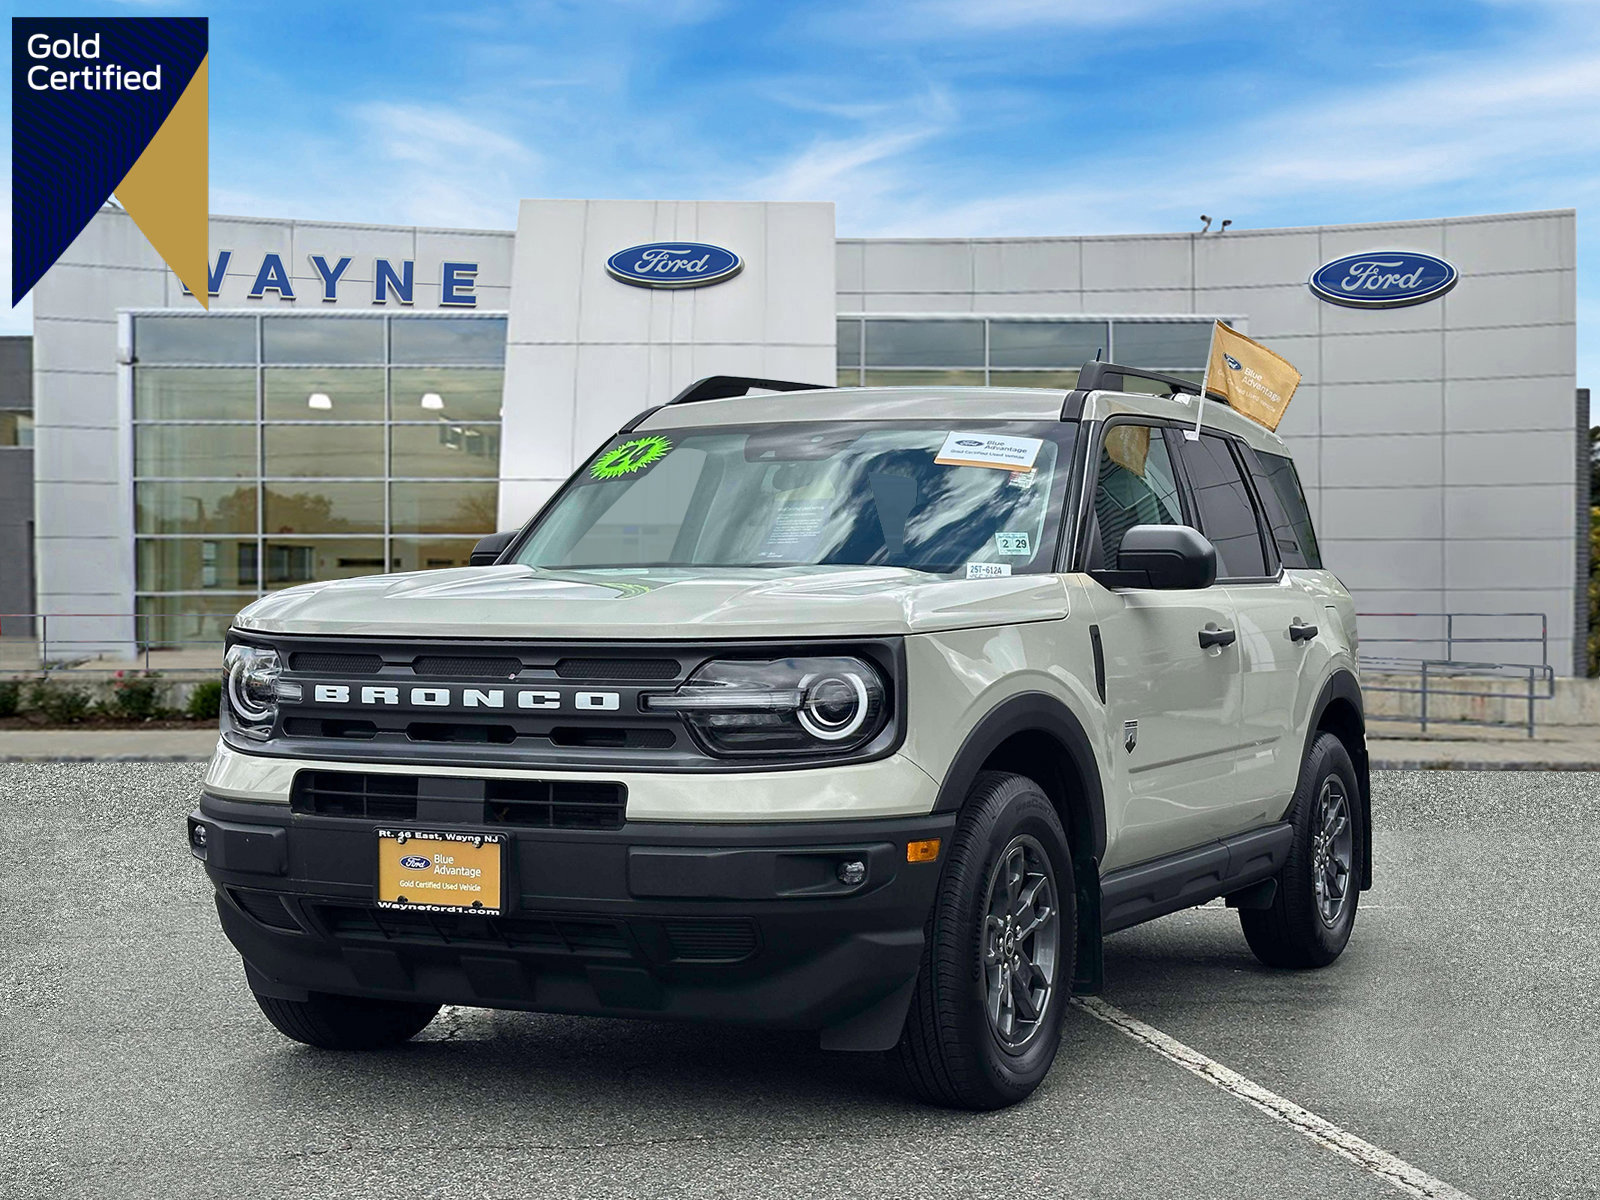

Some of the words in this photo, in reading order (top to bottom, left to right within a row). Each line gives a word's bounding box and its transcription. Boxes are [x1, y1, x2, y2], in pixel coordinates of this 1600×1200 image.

[634, 249, 711, 273] Ford
[1340, 261, 1425, 292] Ford
[1243, 366, 1263, 382] Blue
[984, 445, 1028, 454] Advantage
[1002, 539, 1009, 548] 2
[1015, 539, 1027, 549] 29
[314, 684, 620, 710] BRONCO
[378, 830, 394, 838] Rt.
[415, 832, 442, 841] East,
[446, 833, 481, 843] Wayne
[485, 835, 499, 843] NJ
[434, 854, 454, 865] Blue
[433, 865, 481, 878] Advantage
[399, 880, 414, 888] Gold
[415, 881, 441, 890] Certified
[442, 882, 458, 890] Used
[459, 883, 481, 892] Vehicle
[377, 901, 500, 916] Wayneford1.com
